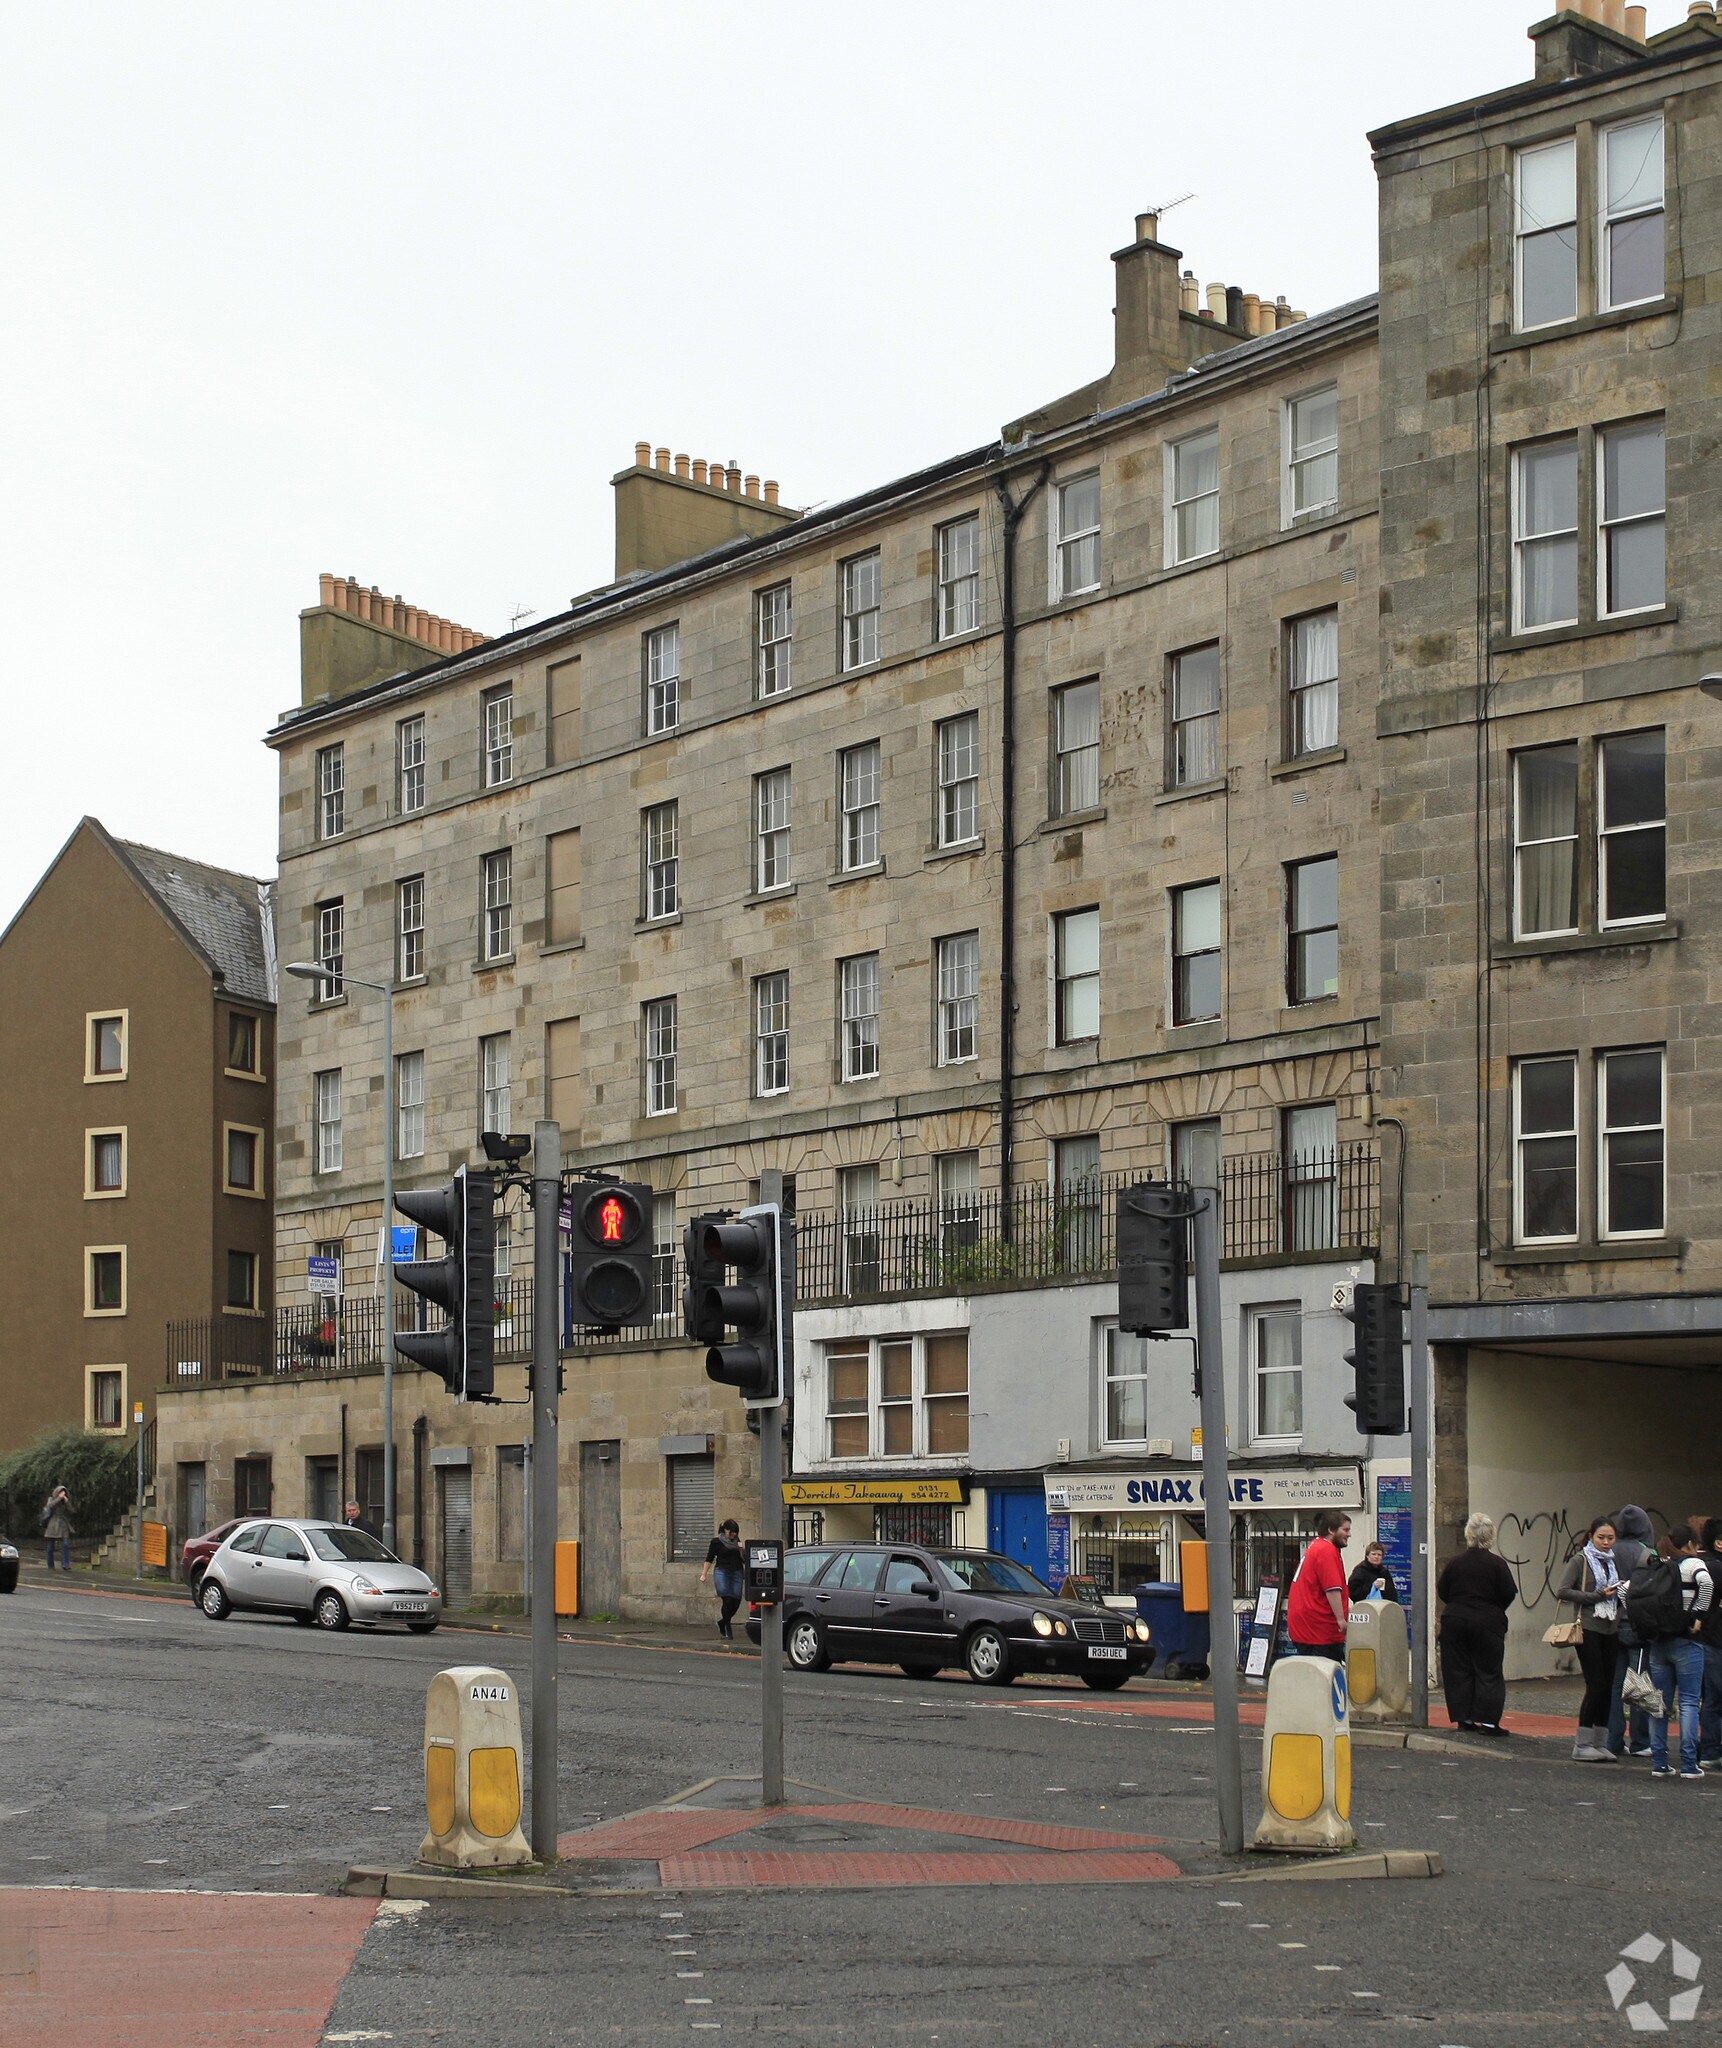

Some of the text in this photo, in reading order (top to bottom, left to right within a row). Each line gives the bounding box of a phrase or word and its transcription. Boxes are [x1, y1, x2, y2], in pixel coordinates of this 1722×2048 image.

[398, 1245, 414, 1254] LET
[1274, 1480, 1289, 1488] FREE
[1318, 1478, 1355, 1487] DELIVERIES
[790, 1484, 904, 1503] Derrick's Takeaway
[1127, 1478, 1194, 1503] SNAX
[1316, 1490, 1328, 1498] 554
[1329, 1490, 1345, 1498] 2000
